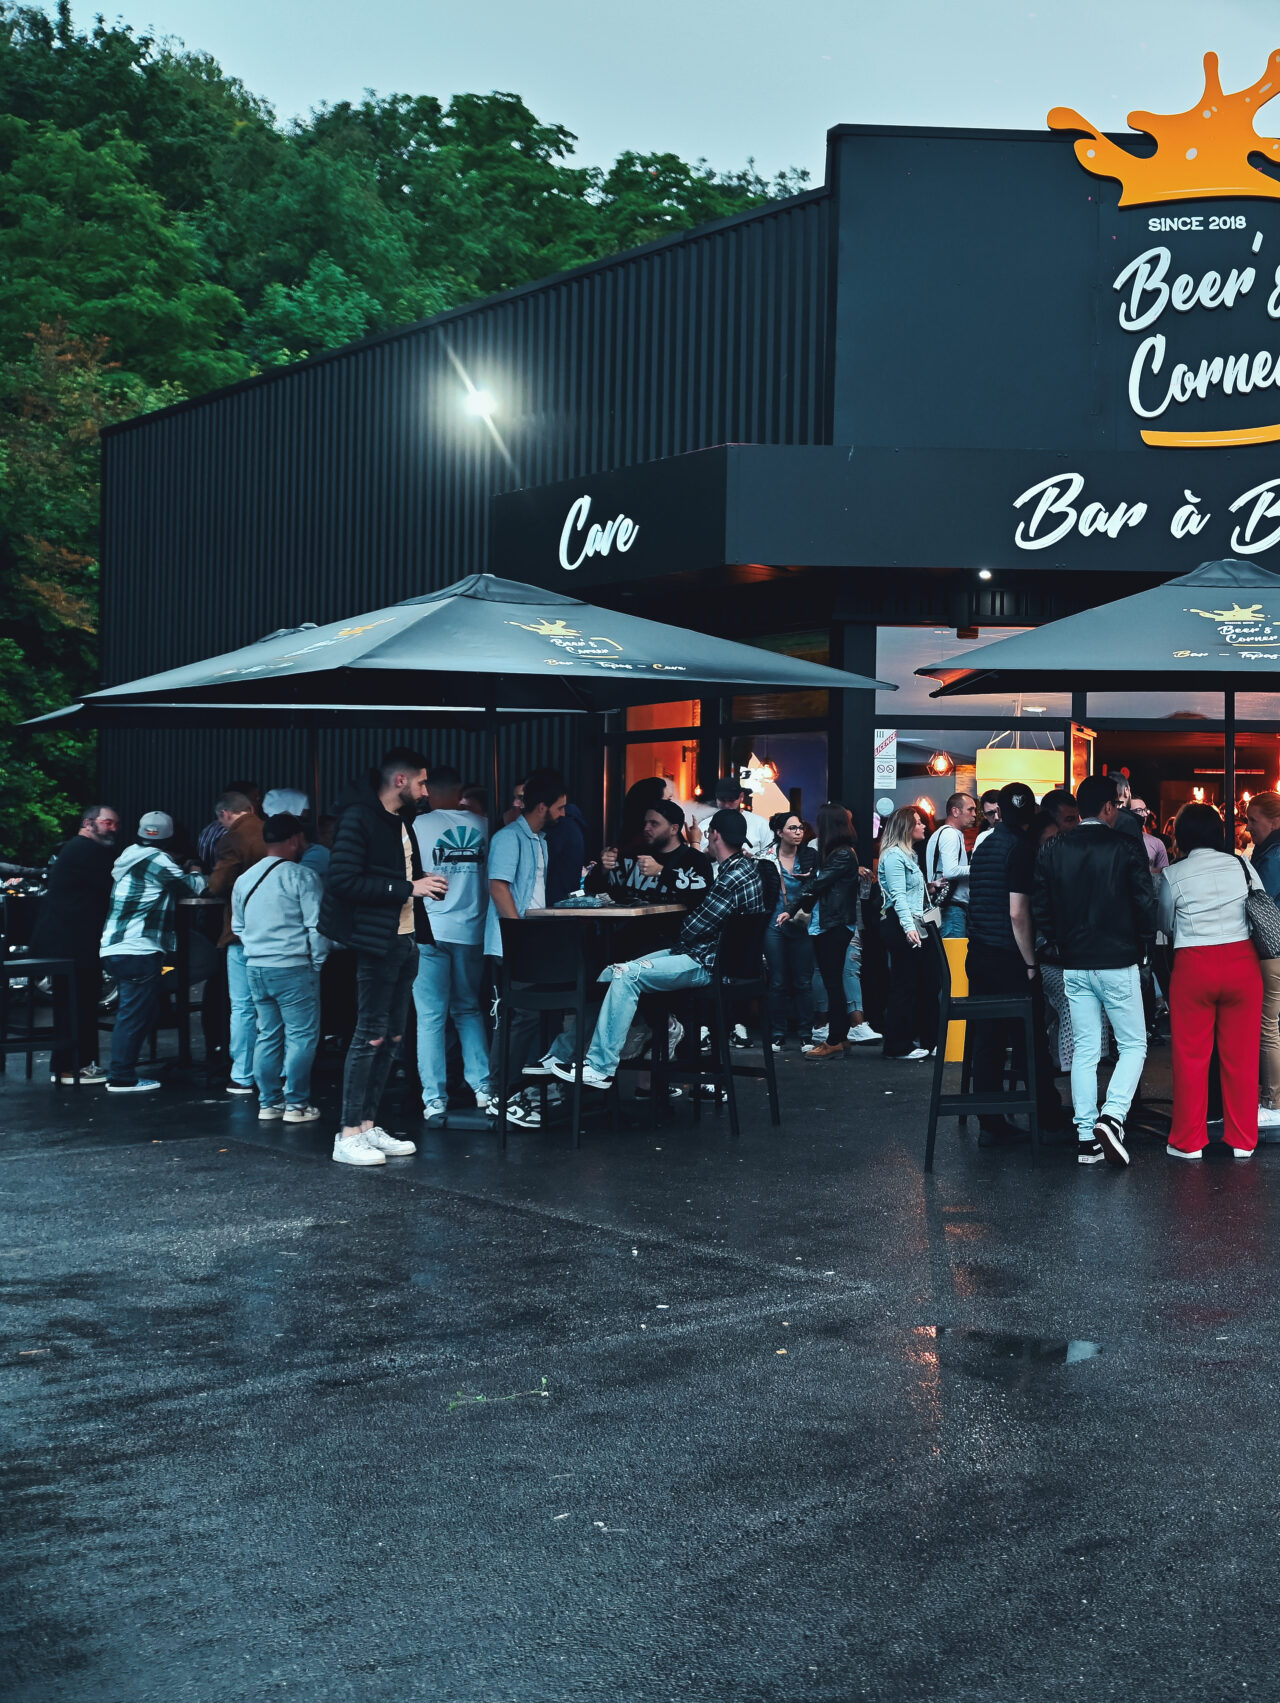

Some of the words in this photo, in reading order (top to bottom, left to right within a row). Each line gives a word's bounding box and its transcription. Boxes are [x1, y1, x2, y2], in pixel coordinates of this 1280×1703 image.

[1148, 216, 1204, 231] SINCE
[1208, 215, 1247, 230] 2018
[1013, 472, 1148, 550] Bar
[1170, 489, 1211, 539] à
[559, 494, 640, 571] Cave
[1217, 624, 1273, 635] Beer's
[1225, 634, 1278, 644] Corner
[1172, 650, 1209, 658] Bar
[1238, 651, 1280, 660] Tapas
[874, 730, 898, 756] LICENCE
